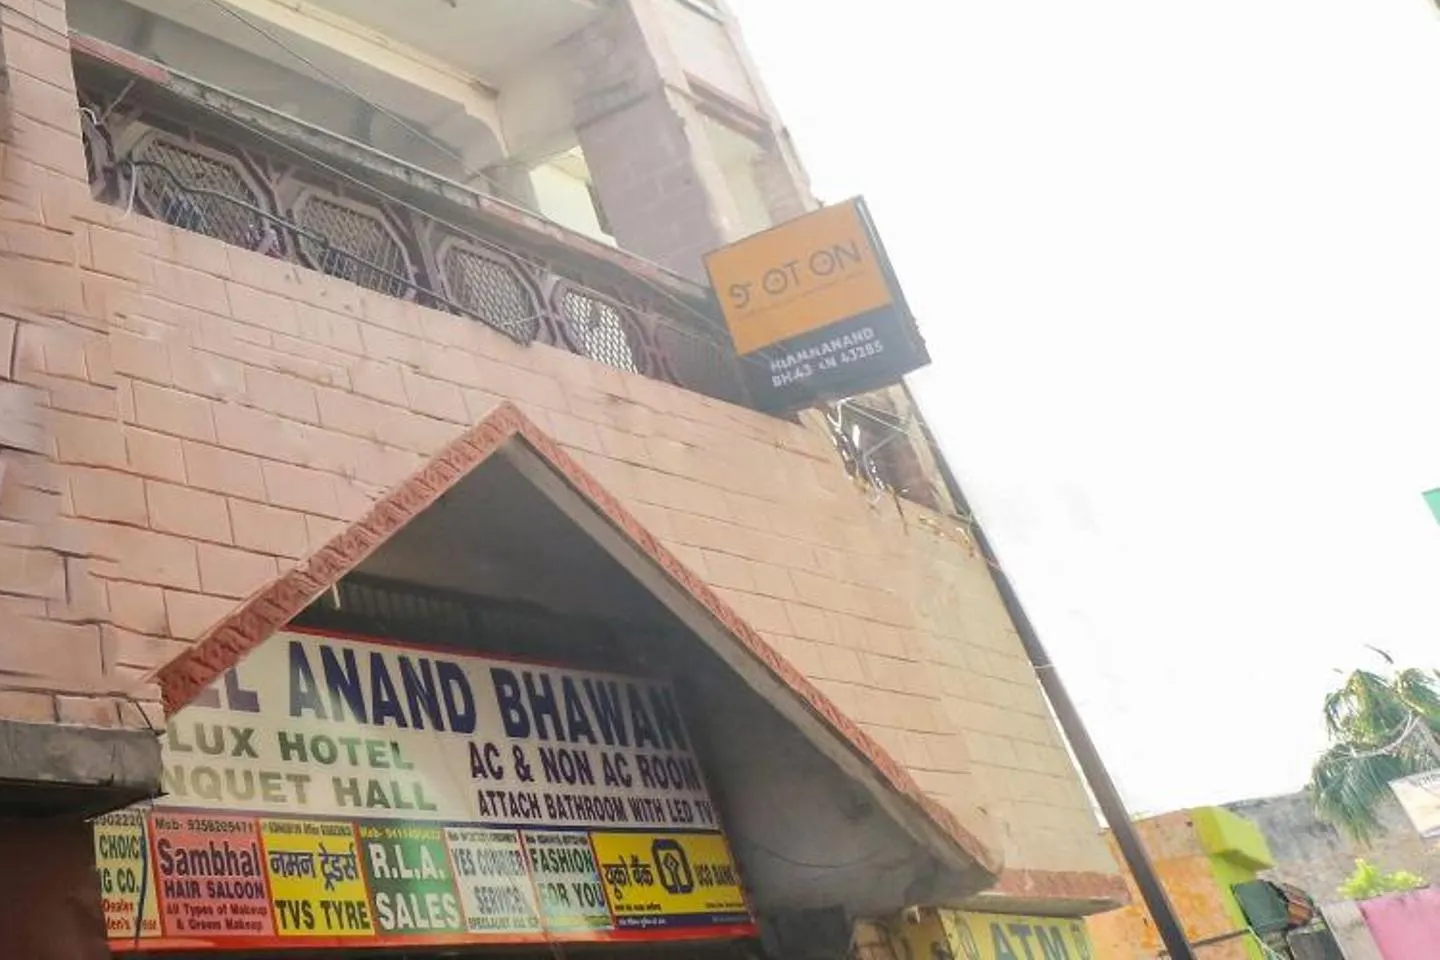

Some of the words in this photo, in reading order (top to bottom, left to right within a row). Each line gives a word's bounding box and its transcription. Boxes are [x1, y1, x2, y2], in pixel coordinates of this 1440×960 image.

[289, 640, 476, 734] ANAND
[489, 667, 690, 752] BHAWAN
[278, 731, 414, 771] HOTEL
[469, 741, 503, 781] AC
[513, 743, 534, 782] &
[538, 746, 594, 786] NON
[601, 752, 632, 789] AC
[332, 775, 438, 812] HALL
[477, 789, 541, 818] ATTACH
[543, 792, 628, 823] BATHROOM
[627, 797, 666, 823] WITH
[666, 799, 693, 823] LED
[99, 835, 144, 859] CHOIC
[157, 837, 261, 877] Sambhal
[368, 842, 446, 880] R.L.A.
[530, 847, 595, 874] FASHION
[116, 867, 140, 893] CO.
[268, 850, 317, 879] नमन
[164, 880, 201, 899] HAIR
[209, 882, 266, 900] SALOON
[572, 882, 605, 908] YOU
[274, 900, 315, 930] TVS
[320, 900, 371, 930] TYRE
[374, 891, 461, 930] SALES
